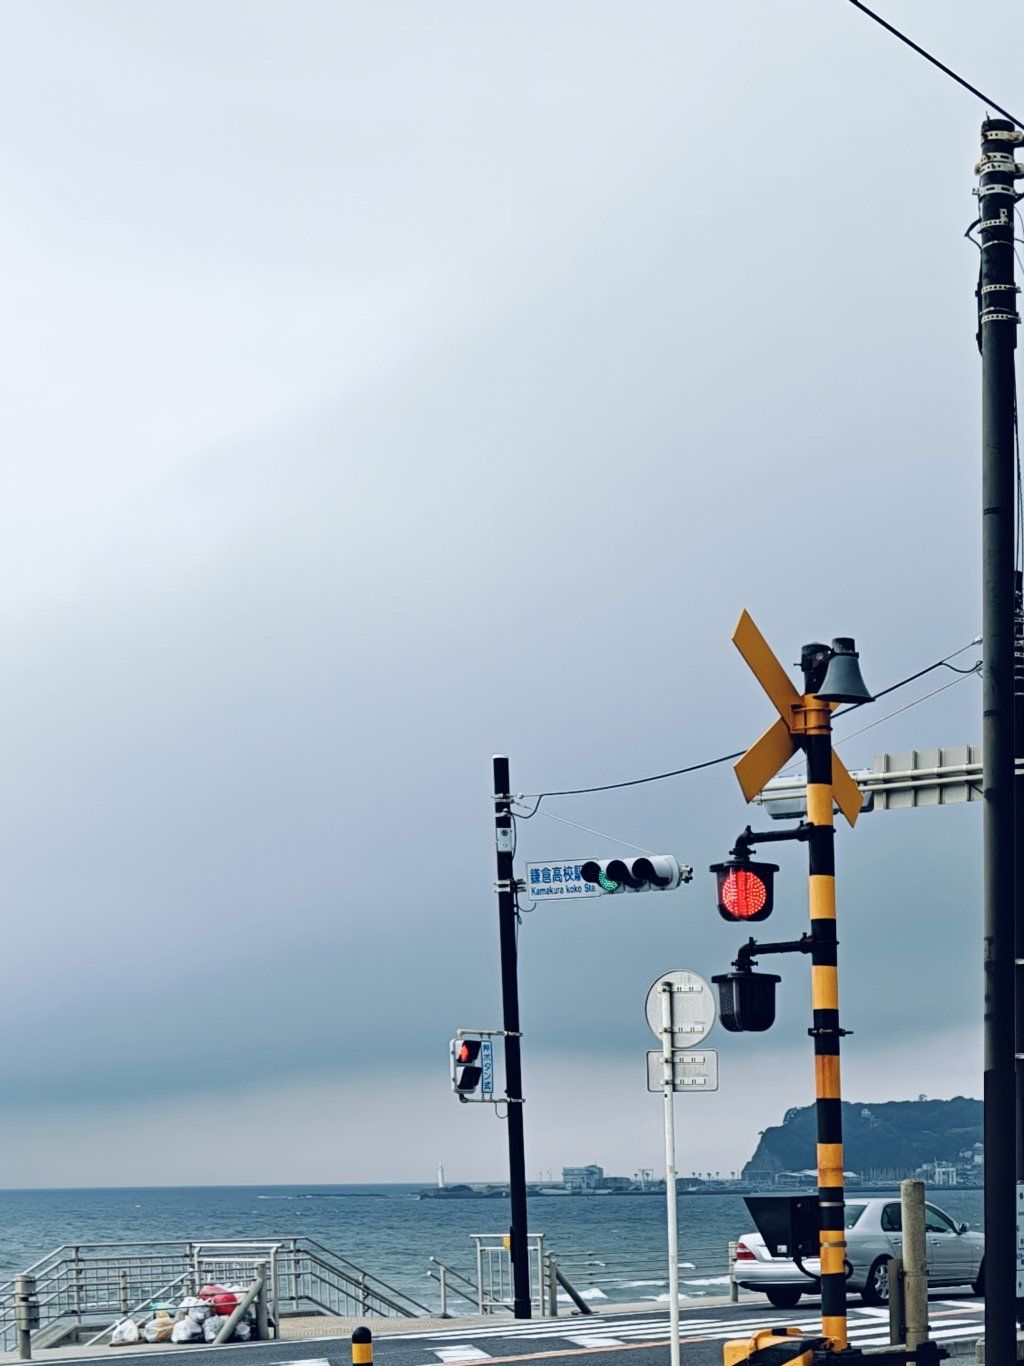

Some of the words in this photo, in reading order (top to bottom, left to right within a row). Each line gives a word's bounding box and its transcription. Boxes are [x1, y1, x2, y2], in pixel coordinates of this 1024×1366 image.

[530, 864, 584, 884] 鎌倉高校駅
[531, 886, 564, 896] Kamakura
[566, 885, 583, 893] koko
